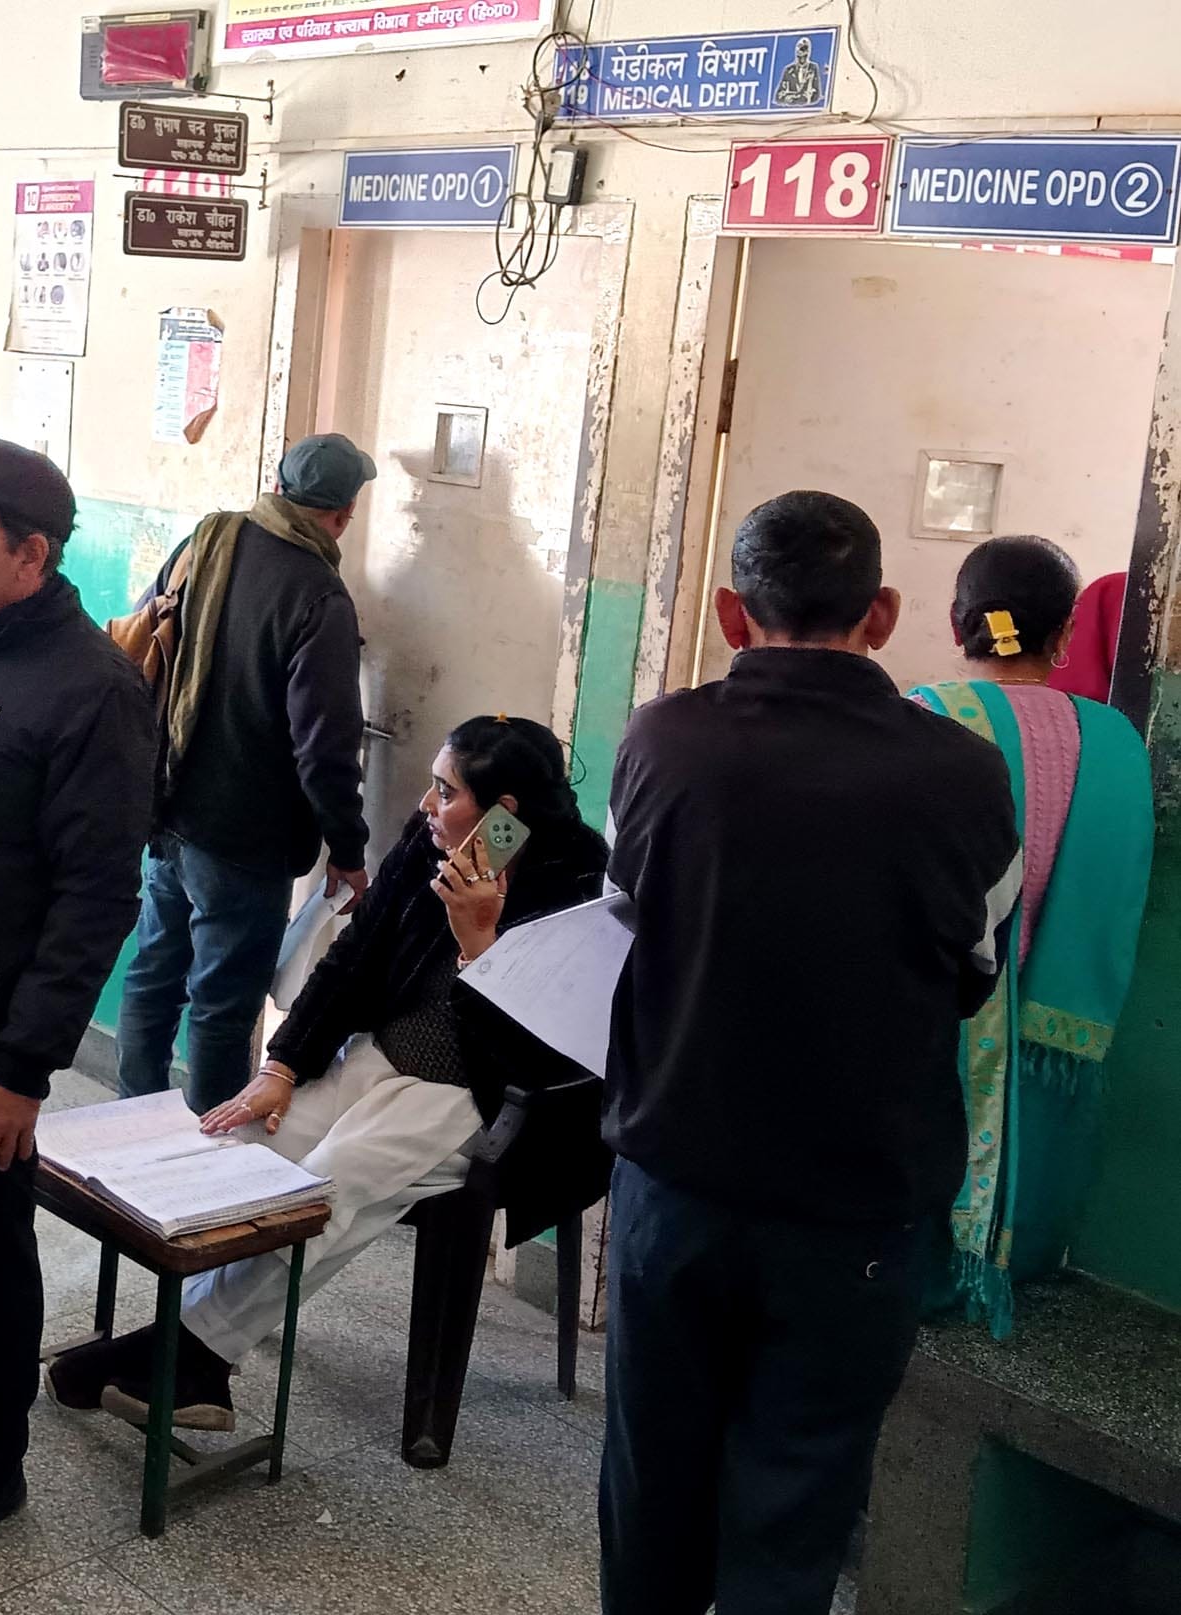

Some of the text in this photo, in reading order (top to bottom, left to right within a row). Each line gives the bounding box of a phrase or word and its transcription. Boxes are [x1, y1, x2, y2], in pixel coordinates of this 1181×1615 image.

[296, 19, 332, 37] परिवार
[373, 12, 411, 30] विभाग
[416, 6, 465, 28] हमीरपुर
[697, 41, 768, 78] विभाग
[603, 81, 761, 111] MEDICAL DEPTT.
[349, 174, 429, 203] MEDICINE
[431, 173, 469, 201] OPD
[740, 151, 872, 220] 118
[909, 168, 1040, 205] MEDICINE
[1045, 169, 1107, 207] OPD
[165, 205, 197, 225] राकेश
[204, 206, 237, 228] चौहान
